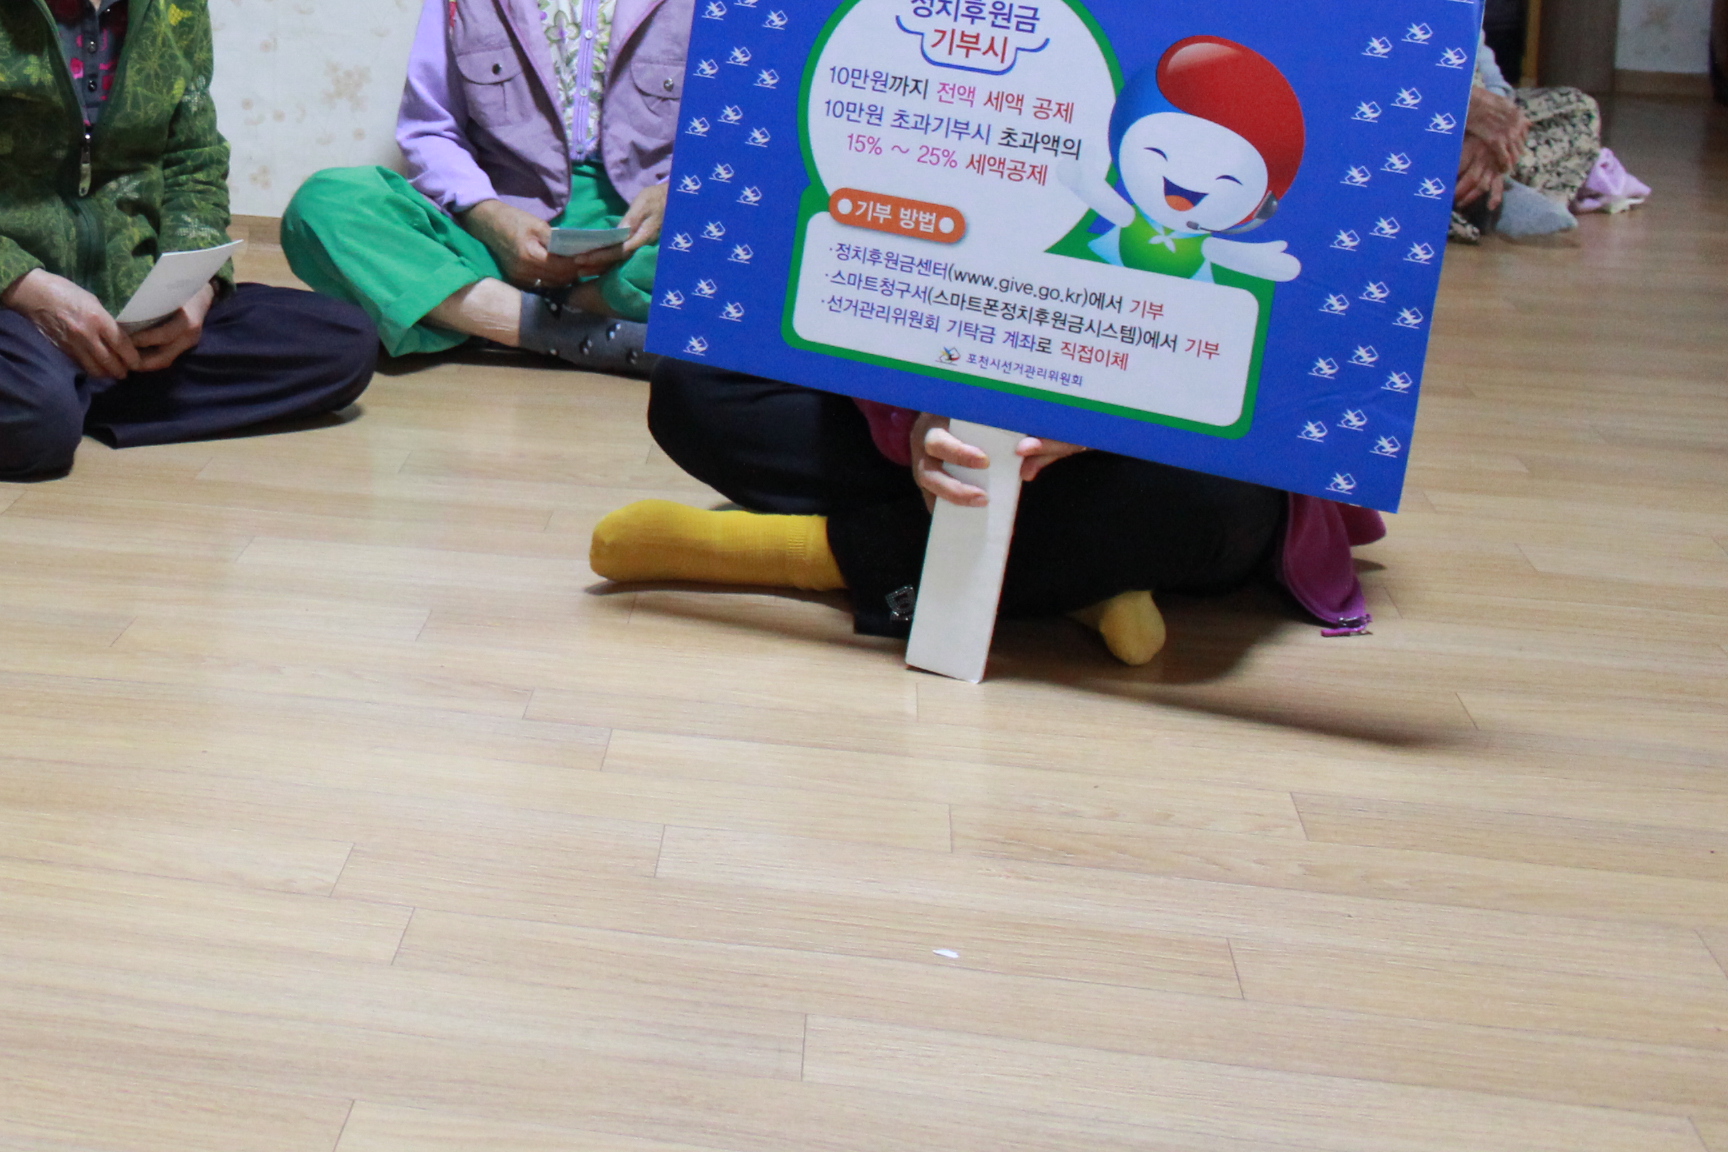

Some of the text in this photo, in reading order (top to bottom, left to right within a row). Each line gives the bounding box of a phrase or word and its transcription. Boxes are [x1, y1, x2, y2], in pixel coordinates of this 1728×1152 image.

[930, 28, 1008, 64] 기부시
[828, 66, 1074, 124] 10만원까지 전액 세액 공제
[824, 99, 1082, 160] 10만원 초과기부시 초과액의
[847, 133, 883, 156] 15%
[917, 145, 958, 169] 25%
[965, 153, 1048, 186] 세액공제
[855, 200, 936, 233] 기부 방법
[1129, 299, 1164, 321] 기부
[826, 295, 1129, 371] 선거관리위원회 기탁금 계좌로 직접이체
[1185, 338, 1220, 360] 기부
[966, 353, 1083, 387] 포천시선거관리위원회
